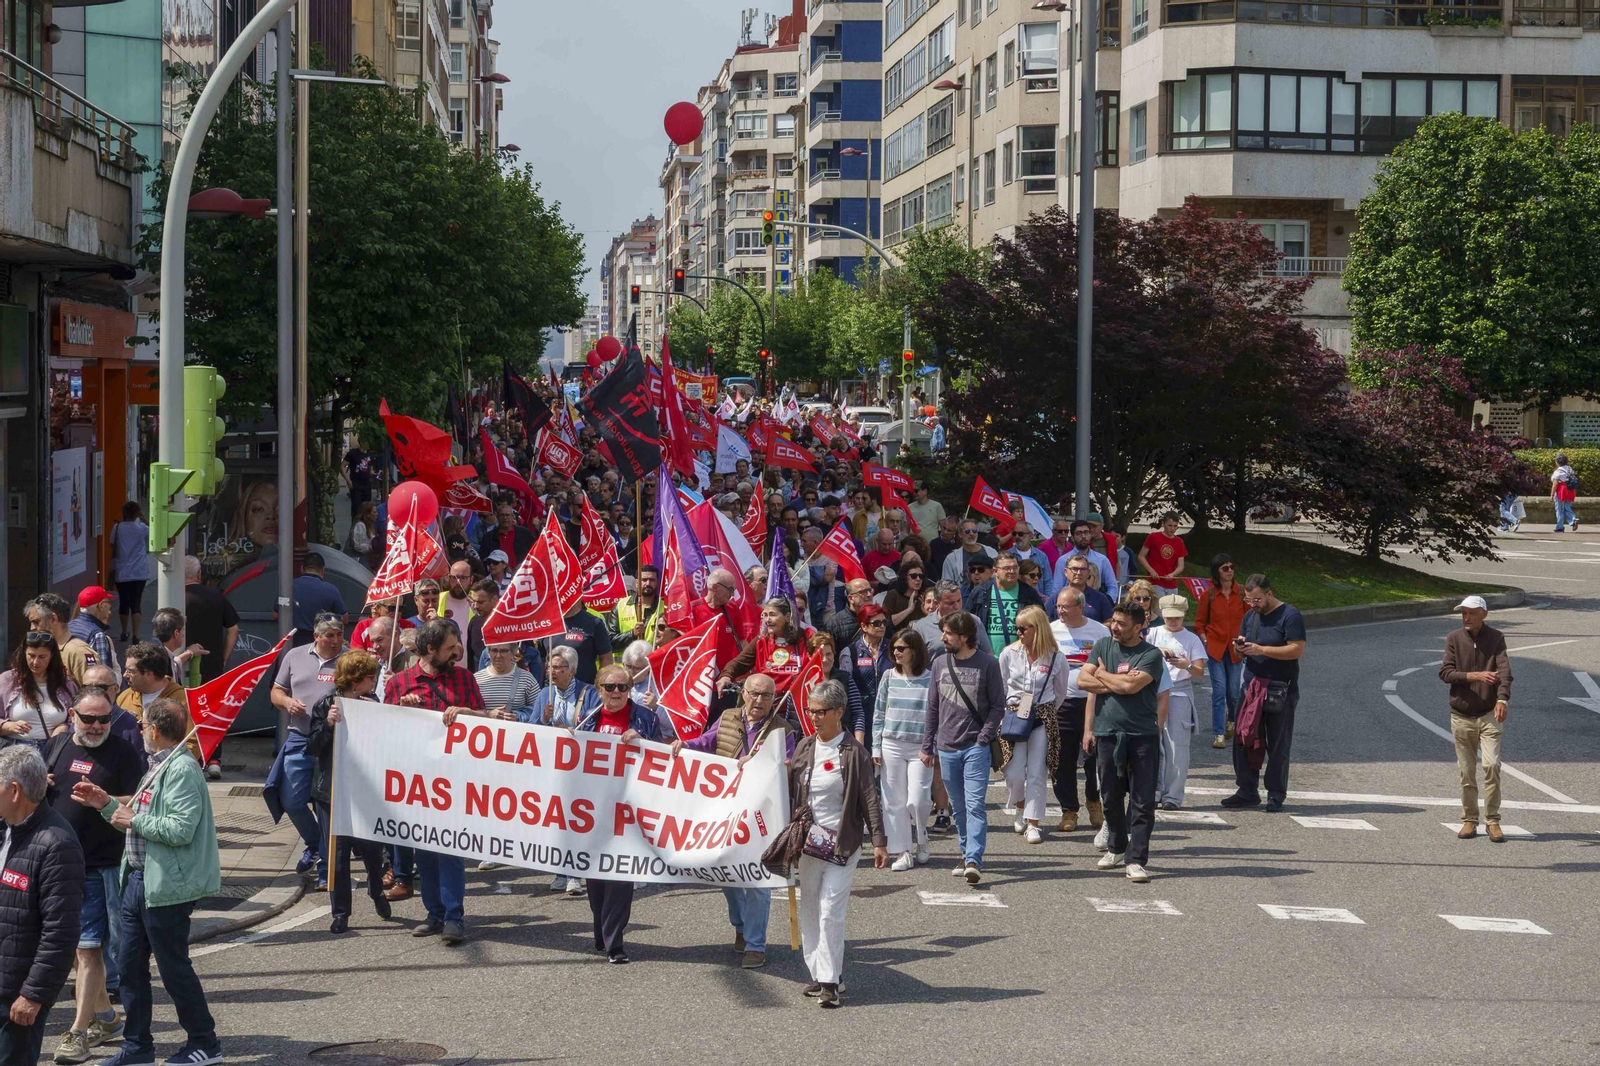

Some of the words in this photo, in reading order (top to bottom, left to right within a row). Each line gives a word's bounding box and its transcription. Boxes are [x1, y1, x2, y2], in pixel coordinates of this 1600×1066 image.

[775, 190, 789, 285] HOTEL
[550, 444, 568, 463] UGT
[776, 446, 807, 463] CCO
[873, 472, 909, 486] COO
[494, 618, 552, 634] www.ugt.es
[71, 762, 92, 771] CCOO
[444, 722, 541, 767] POLA
[554, 736, 743, 799] DEFENSA
[384, 769, 452, 811] DAS
[465, 781, 595, 834] NOSAS
[373, 817, 484, 854] ASOCIACIÓN
[489, 836, 514, 859] DE
[520, 841, 590, 871] VIUDAS
[712, 865, 736, 882] DE
[3, 870, 20, 885] UGT
